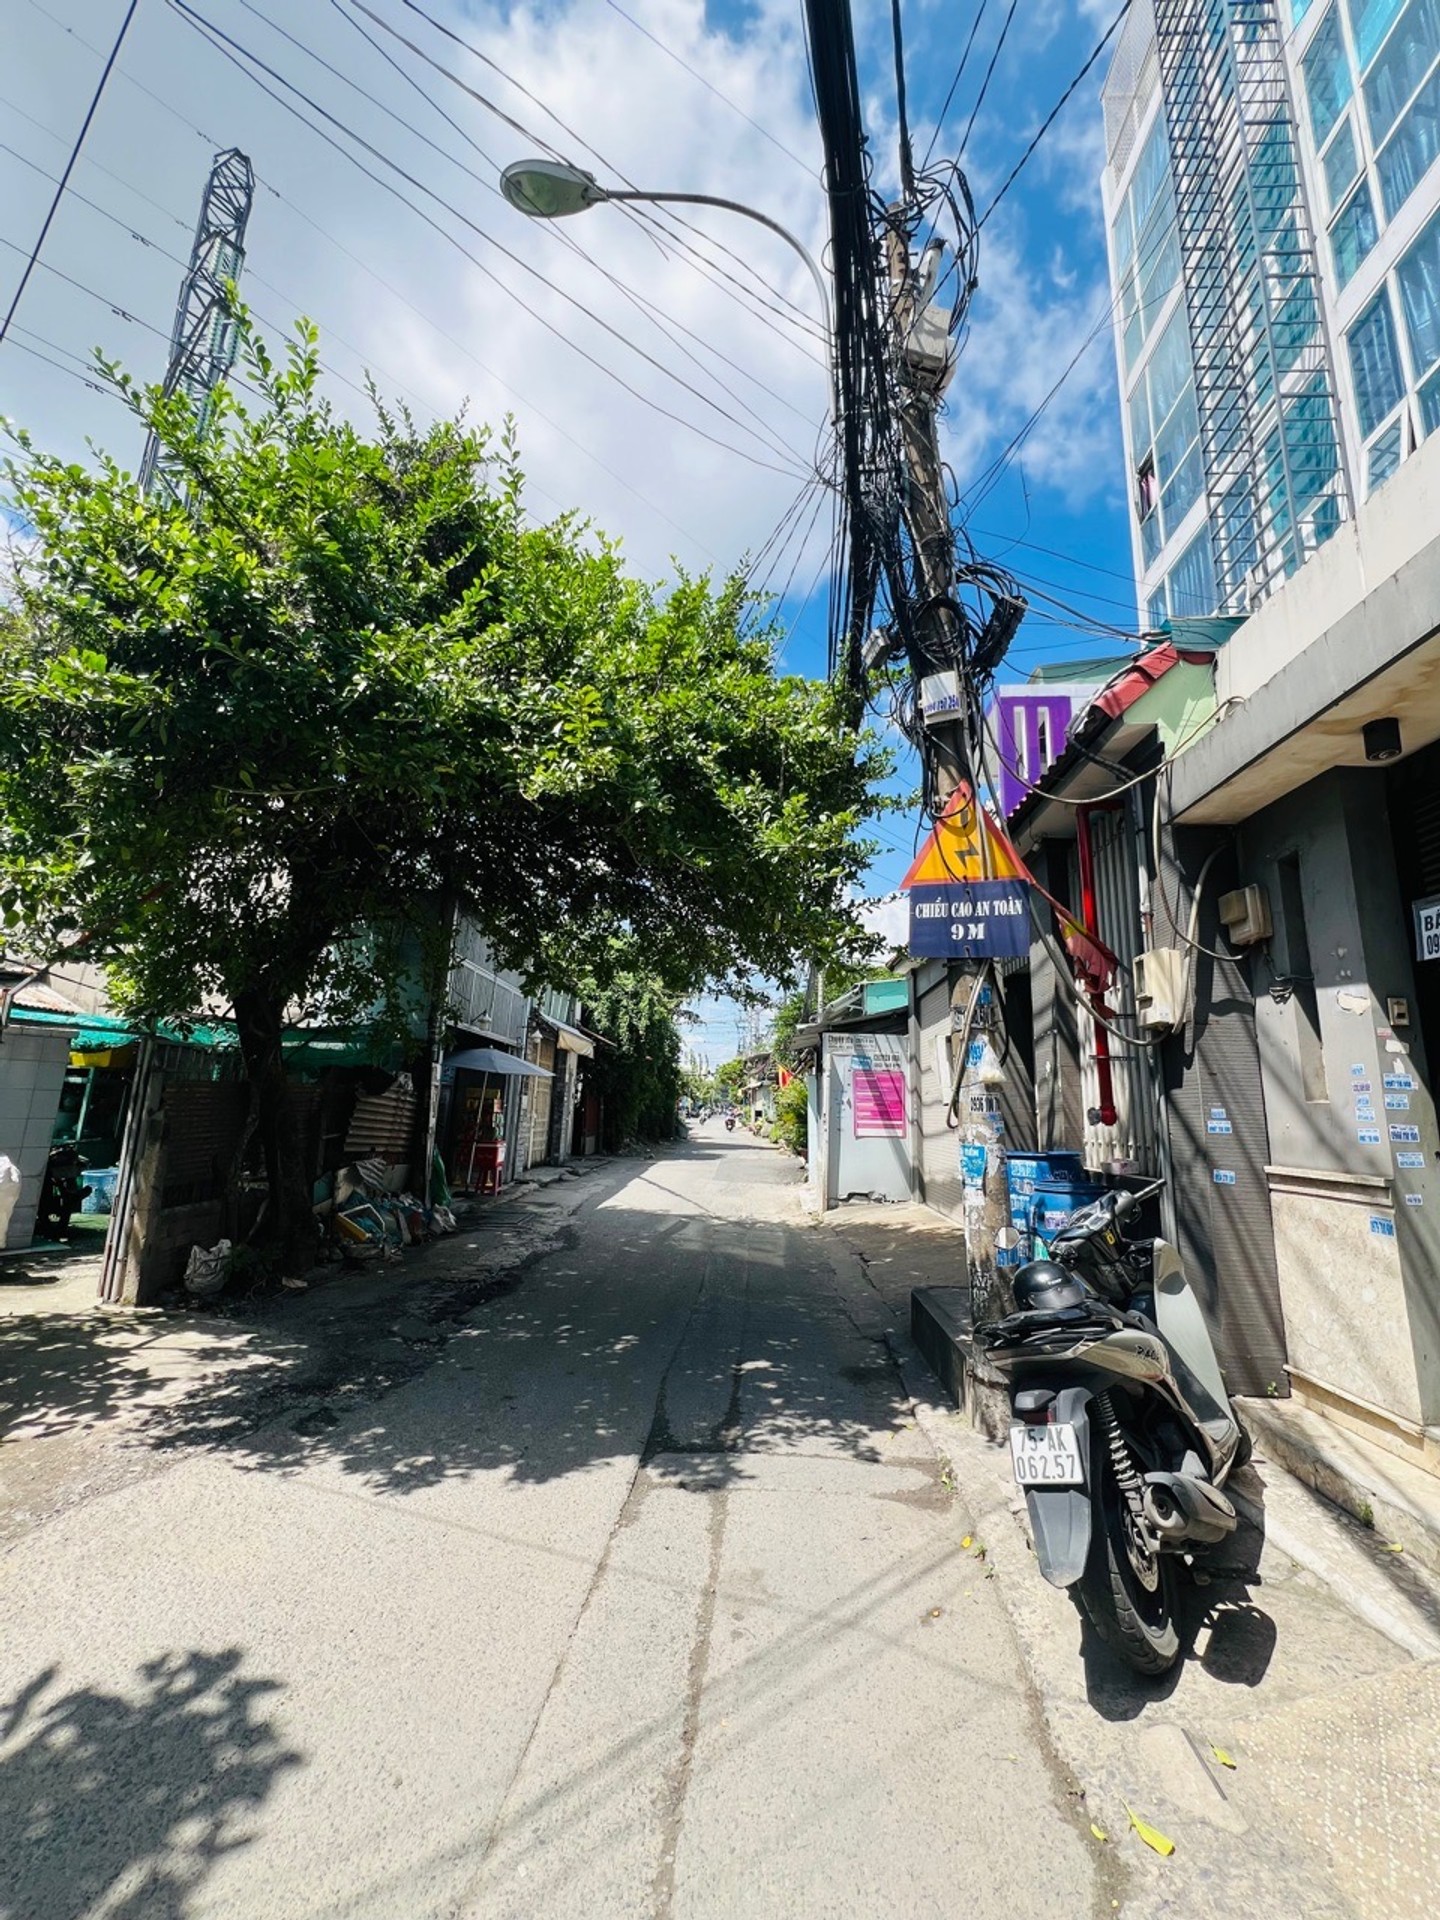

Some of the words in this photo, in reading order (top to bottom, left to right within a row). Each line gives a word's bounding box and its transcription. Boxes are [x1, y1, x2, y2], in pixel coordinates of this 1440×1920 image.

[951, 902, 973, 917] CAO
[975, 901, 990, 916] AN
[993, 896, 1022, 916] TOÀN
[950, 923, 964, 940] 9
[967, 923, 985, 940] M
[1018, 1427, 1067, 1453] 75-AK
[1016, 1454, 1075, 1480] 062.57
